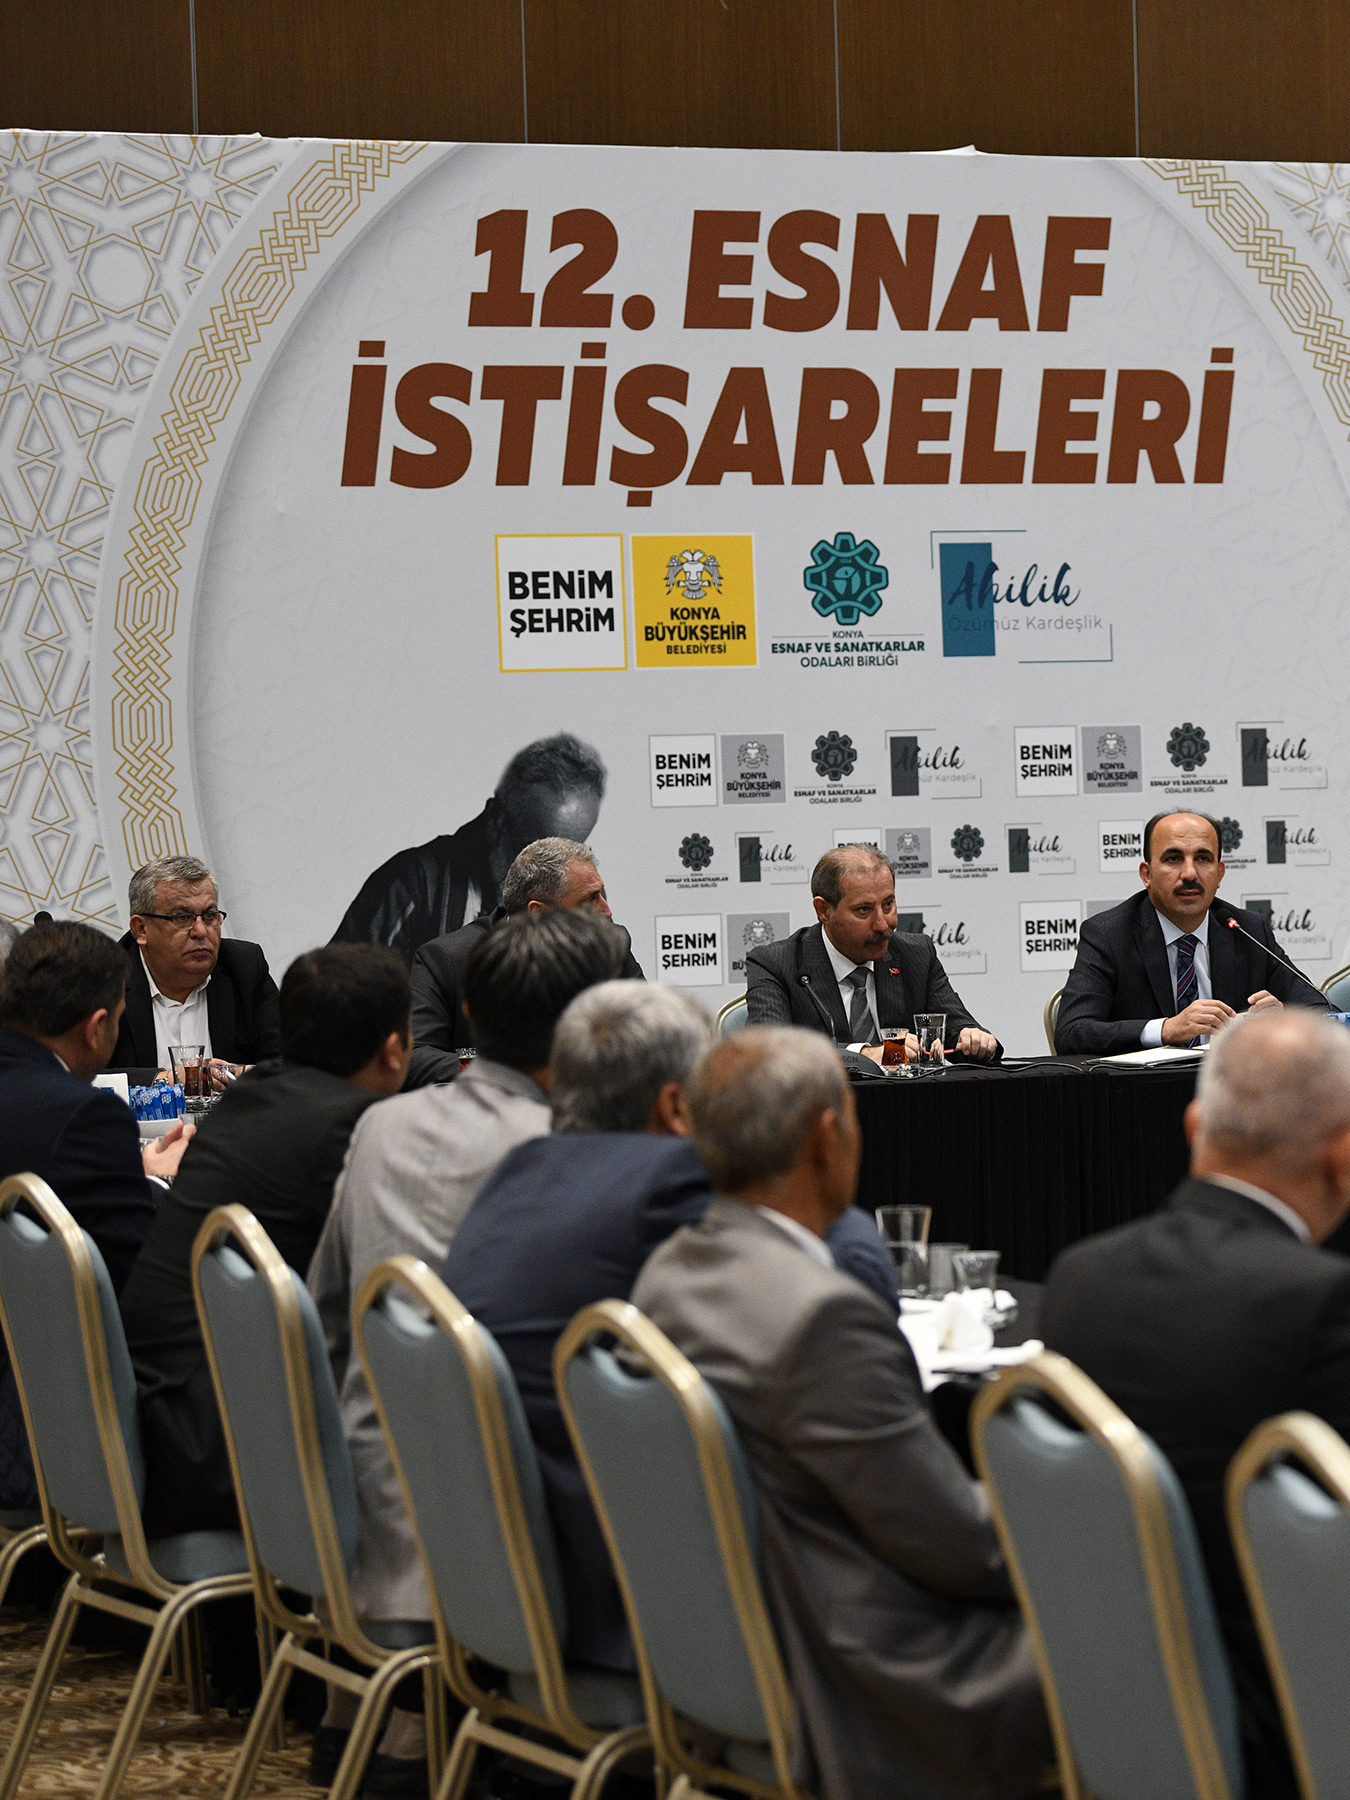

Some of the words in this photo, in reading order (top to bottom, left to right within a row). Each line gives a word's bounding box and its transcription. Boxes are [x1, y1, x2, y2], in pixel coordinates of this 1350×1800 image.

[468, 208, 656, 331] 12.
[683, 209, 1112, 333] ESNAF
[340, 339, 1236, 508] İSTİŞARELERİ
[948, 560, 1081, 611] Ahilik
[670, 607, 720, 621] KONYA
[1026, 614, 1103, 633] Kardeşlik
[644, 621, 747, 643] BÜYÜKŞEHİR
[832, 630, 864, 639] KONYA
[666, 642, 727, 655] BELEDİYESİ
[771, 642, 812, 654] ESNAF
[814, 642, 832, 653] VE
[834, 640, 925, 653] SANATKARLAR
[800, 656, 854, 668] ODALARI
[740, 772, 767, 780] KONYA
